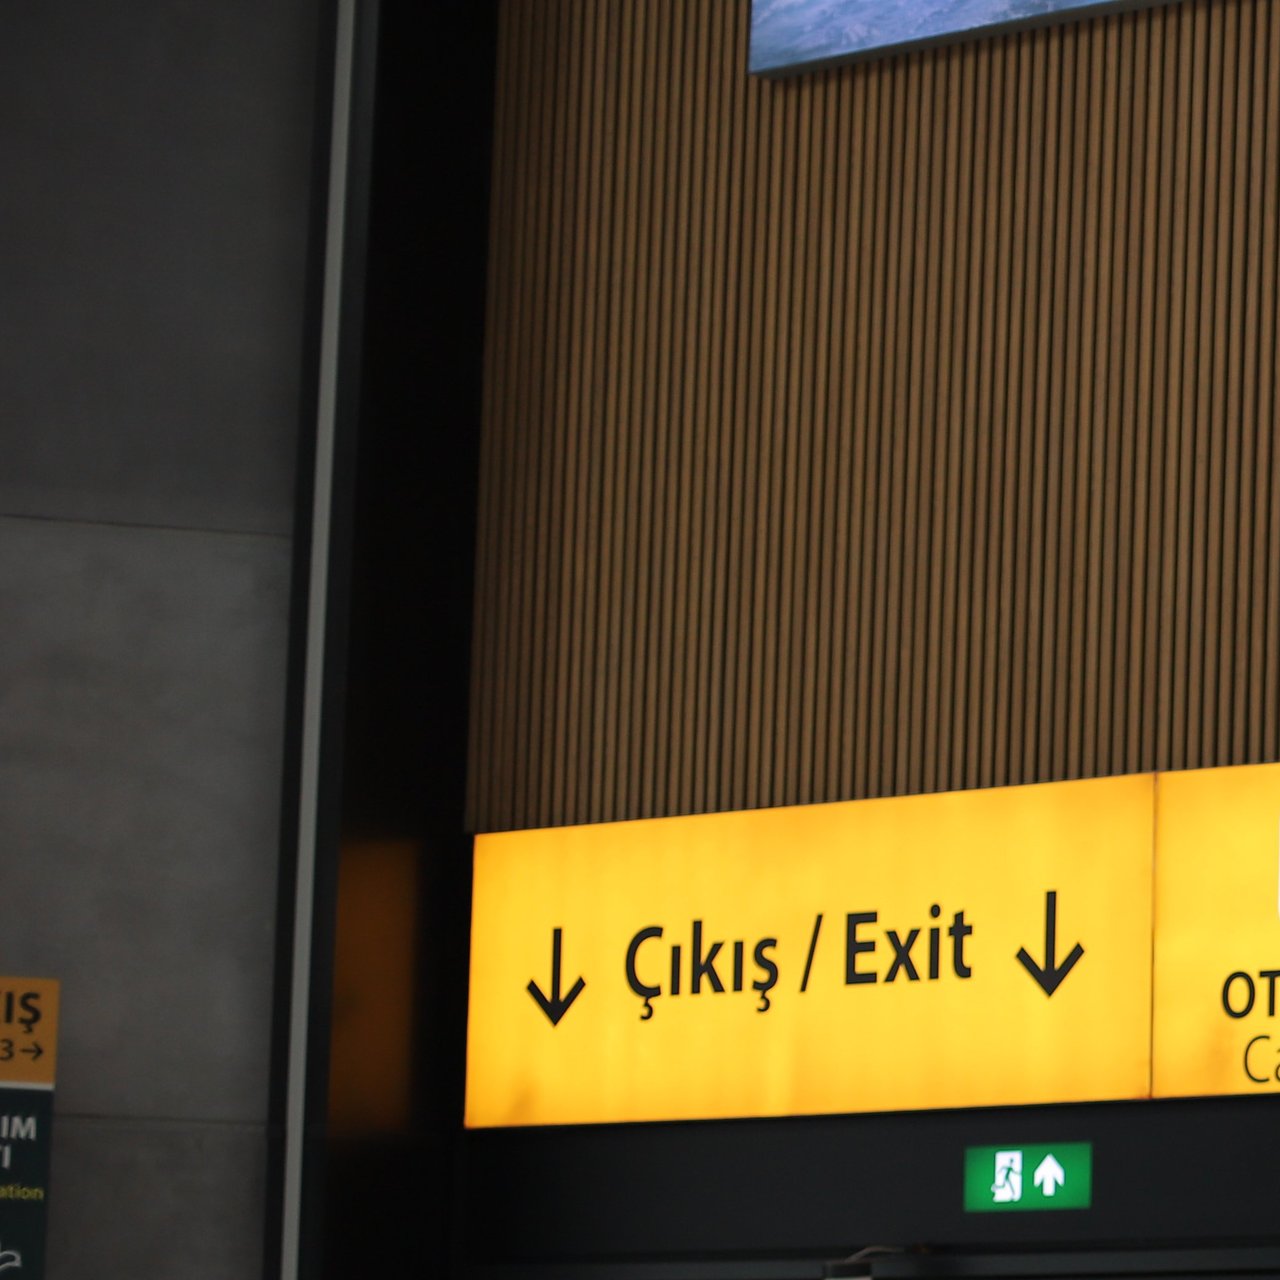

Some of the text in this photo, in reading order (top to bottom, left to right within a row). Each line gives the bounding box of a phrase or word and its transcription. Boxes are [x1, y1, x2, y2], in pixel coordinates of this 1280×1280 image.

[624, 902, 974, 1021] Çıkış / Exit
[0, 990, 42, 1034] IŞ
